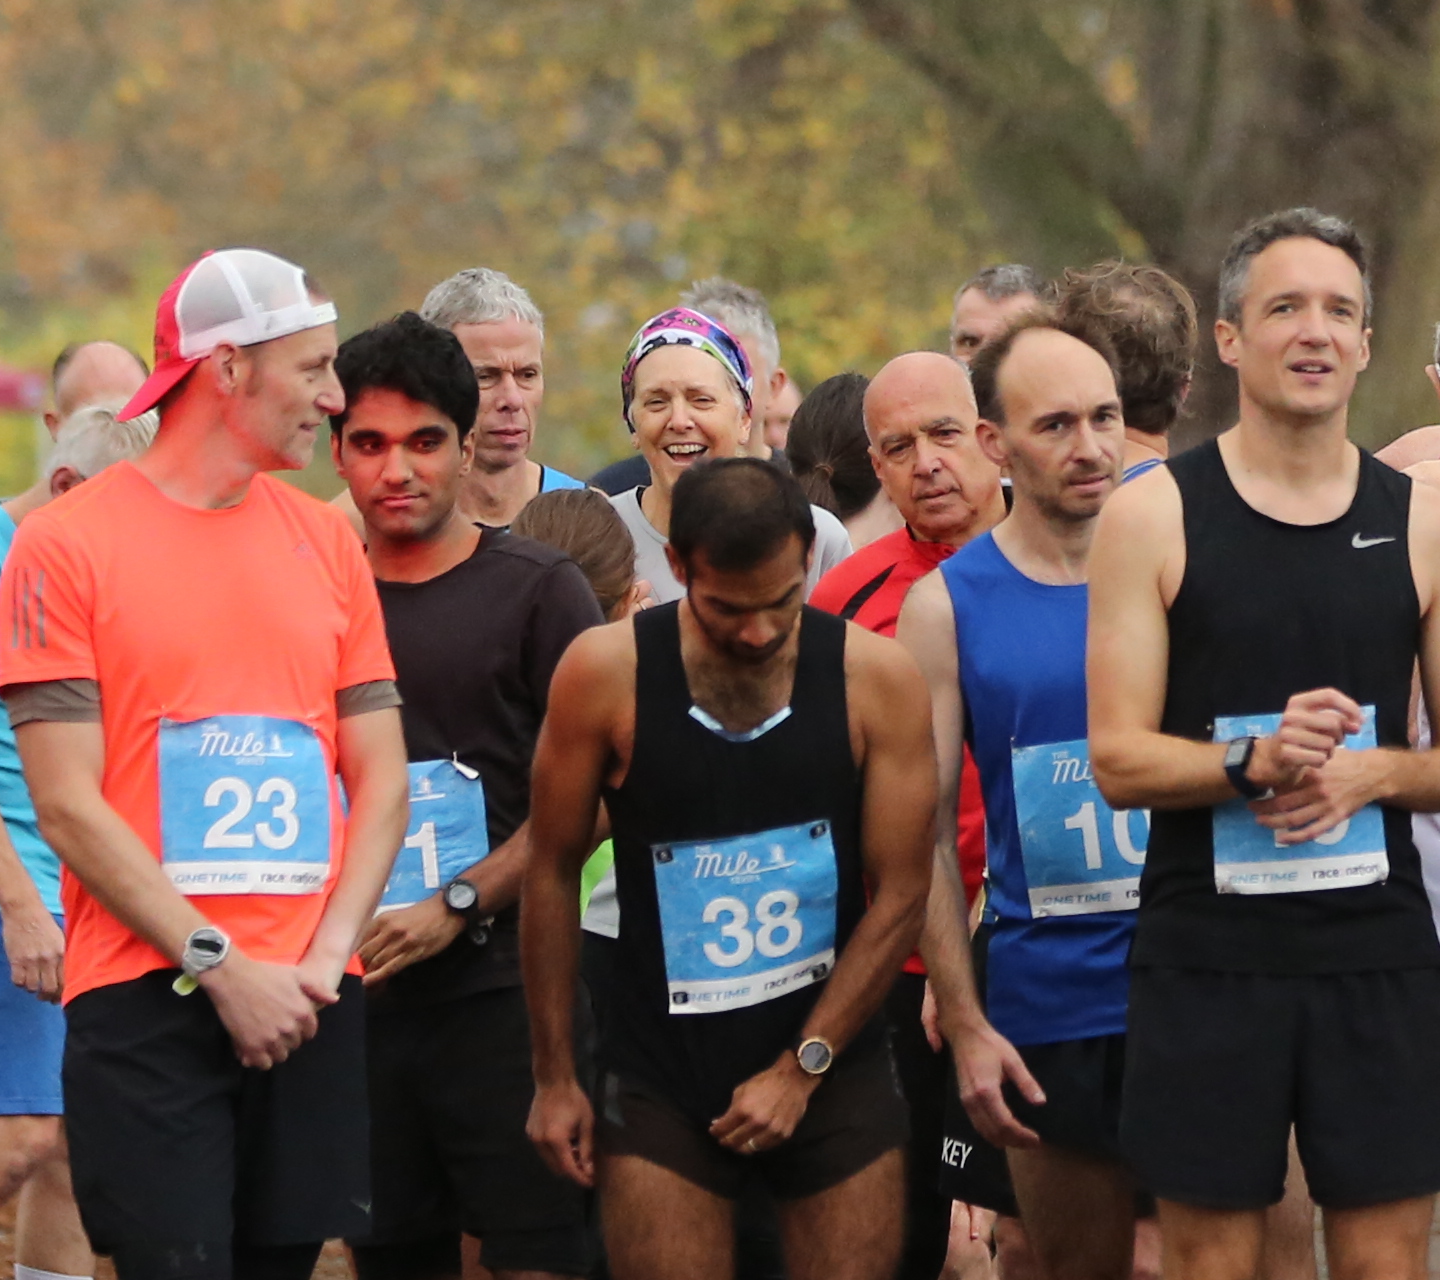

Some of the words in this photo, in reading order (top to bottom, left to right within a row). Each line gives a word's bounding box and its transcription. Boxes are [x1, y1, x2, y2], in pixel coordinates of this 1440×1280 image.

[199, 732, 294, 757] Mile
[1052, 758, 1094, 785] Mi
[203, 776, 300, 850] 23
[1064, 801, 1151, 870] 10
[174, 872, 248, 884] ONETIME
[695, 851, 796, 878] Mile
[1312, 866, 1339, 879] race
[1043, 891, 1111, 905] ONETIME
[1126, 888, 1139, 900] ra
[702, 890, 802, 967] 38
[941, 1136, 973, 1169] KEY
